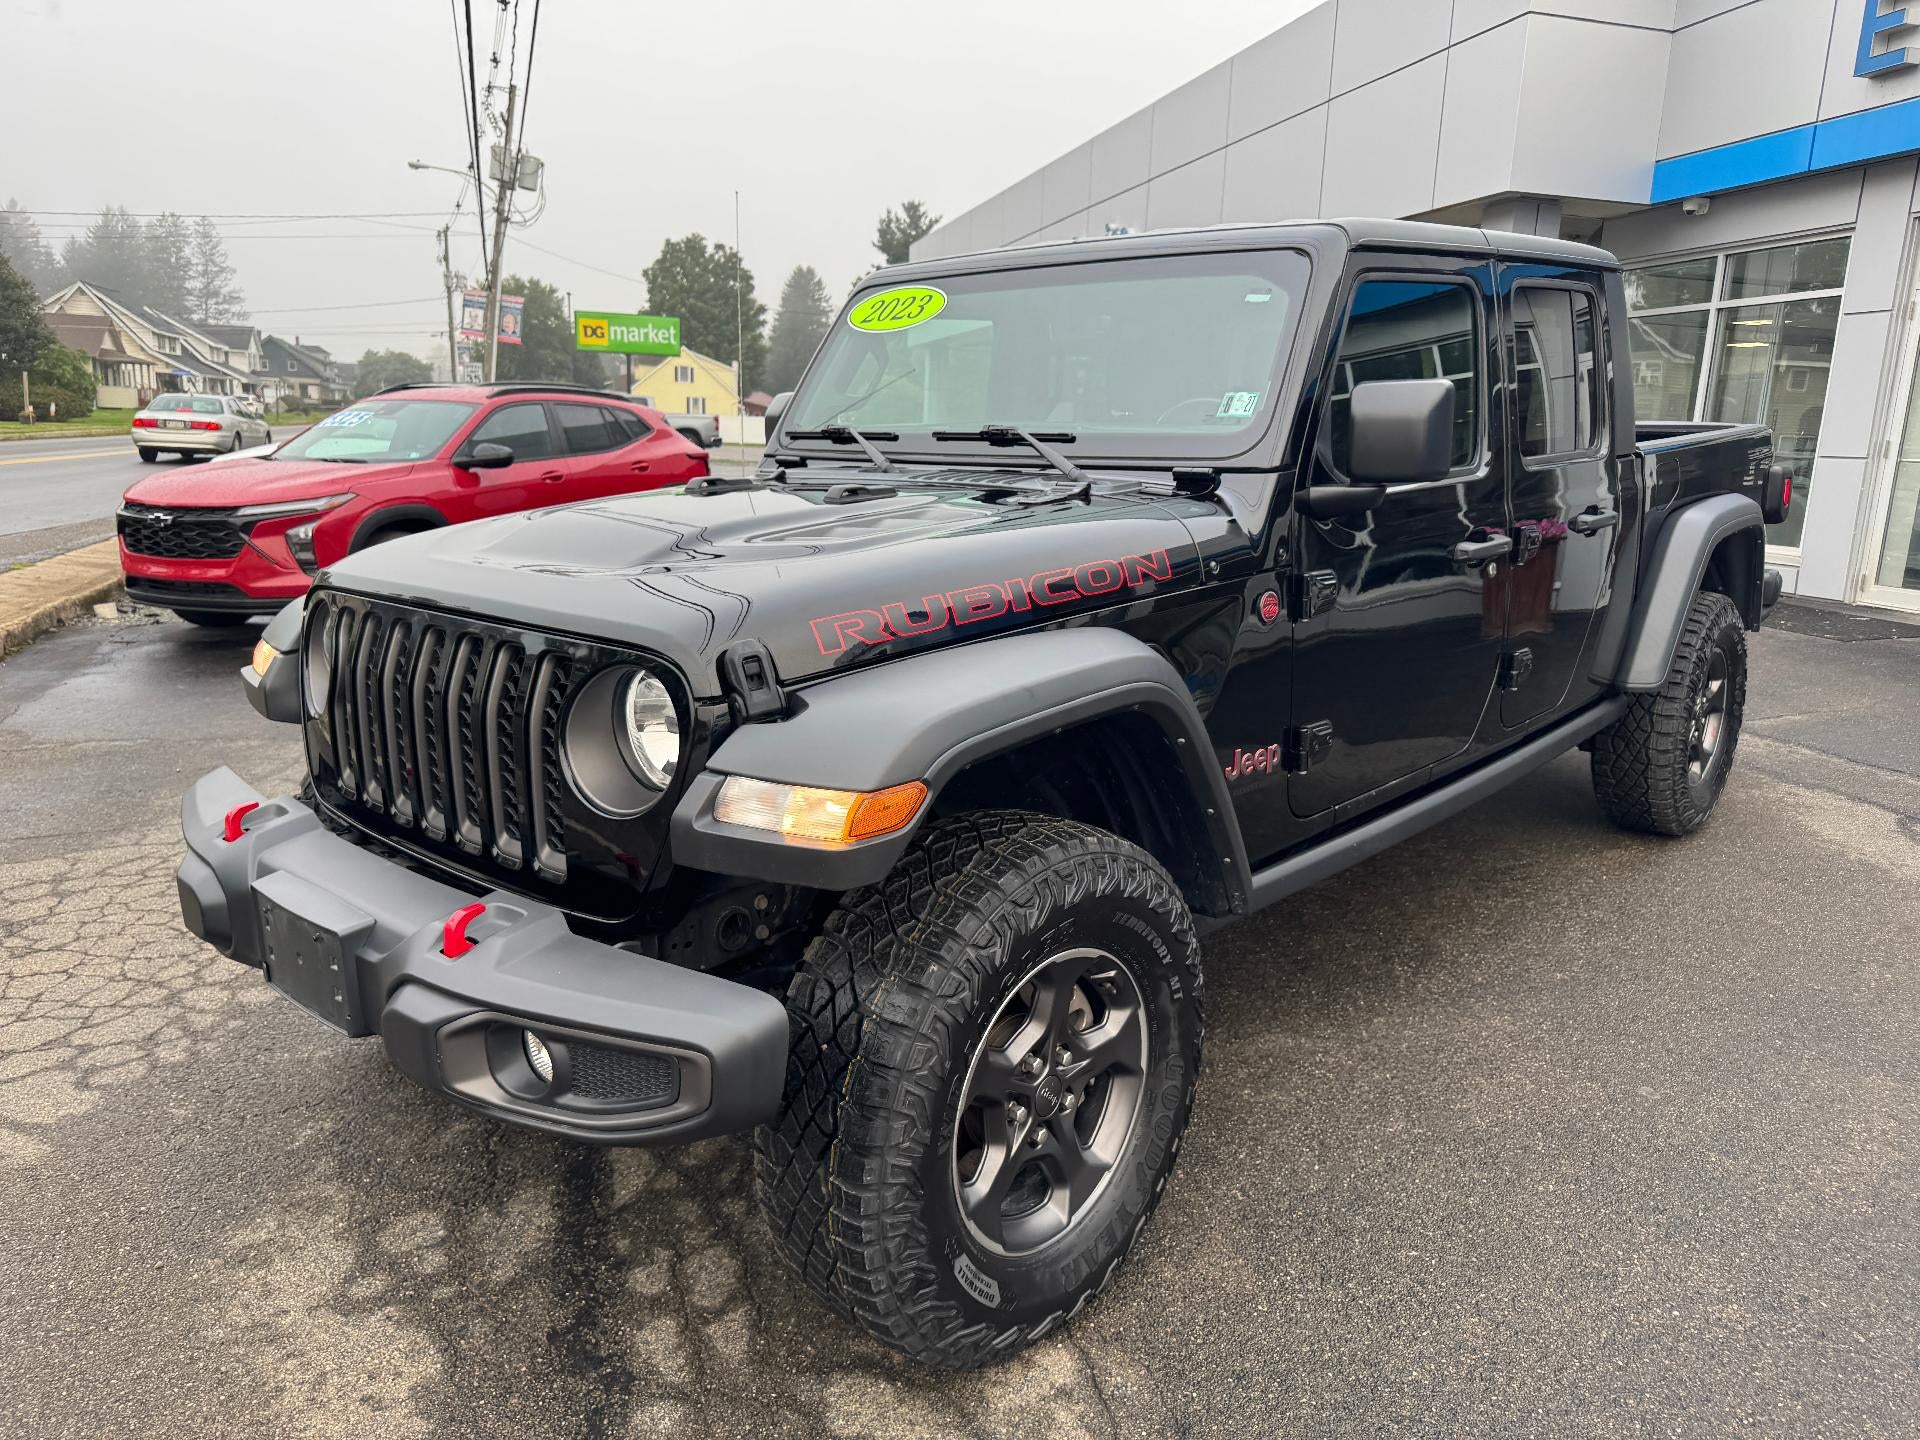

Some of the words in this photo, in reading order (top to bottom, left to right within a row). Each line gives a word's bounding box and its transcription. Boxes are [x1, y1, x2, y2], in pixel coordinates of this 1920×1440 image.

[860, 294, 934, 324] 2023
[582, 325, 606, 339] DG
[609, 323, 677, 345] market
[1244, 395, 1256, 413] 27
[809, 549, 1173, 655] RUBICON
[1224, 743, 1281, 781] Jeep
[1112, 911, 1173, 965] TERRITORY
[1169, 975, 1184, 1000] MT
[1062, 1053, 1185, 1293] GOODYEAR
[957, 1265, 996, 1303] DURAWALL
